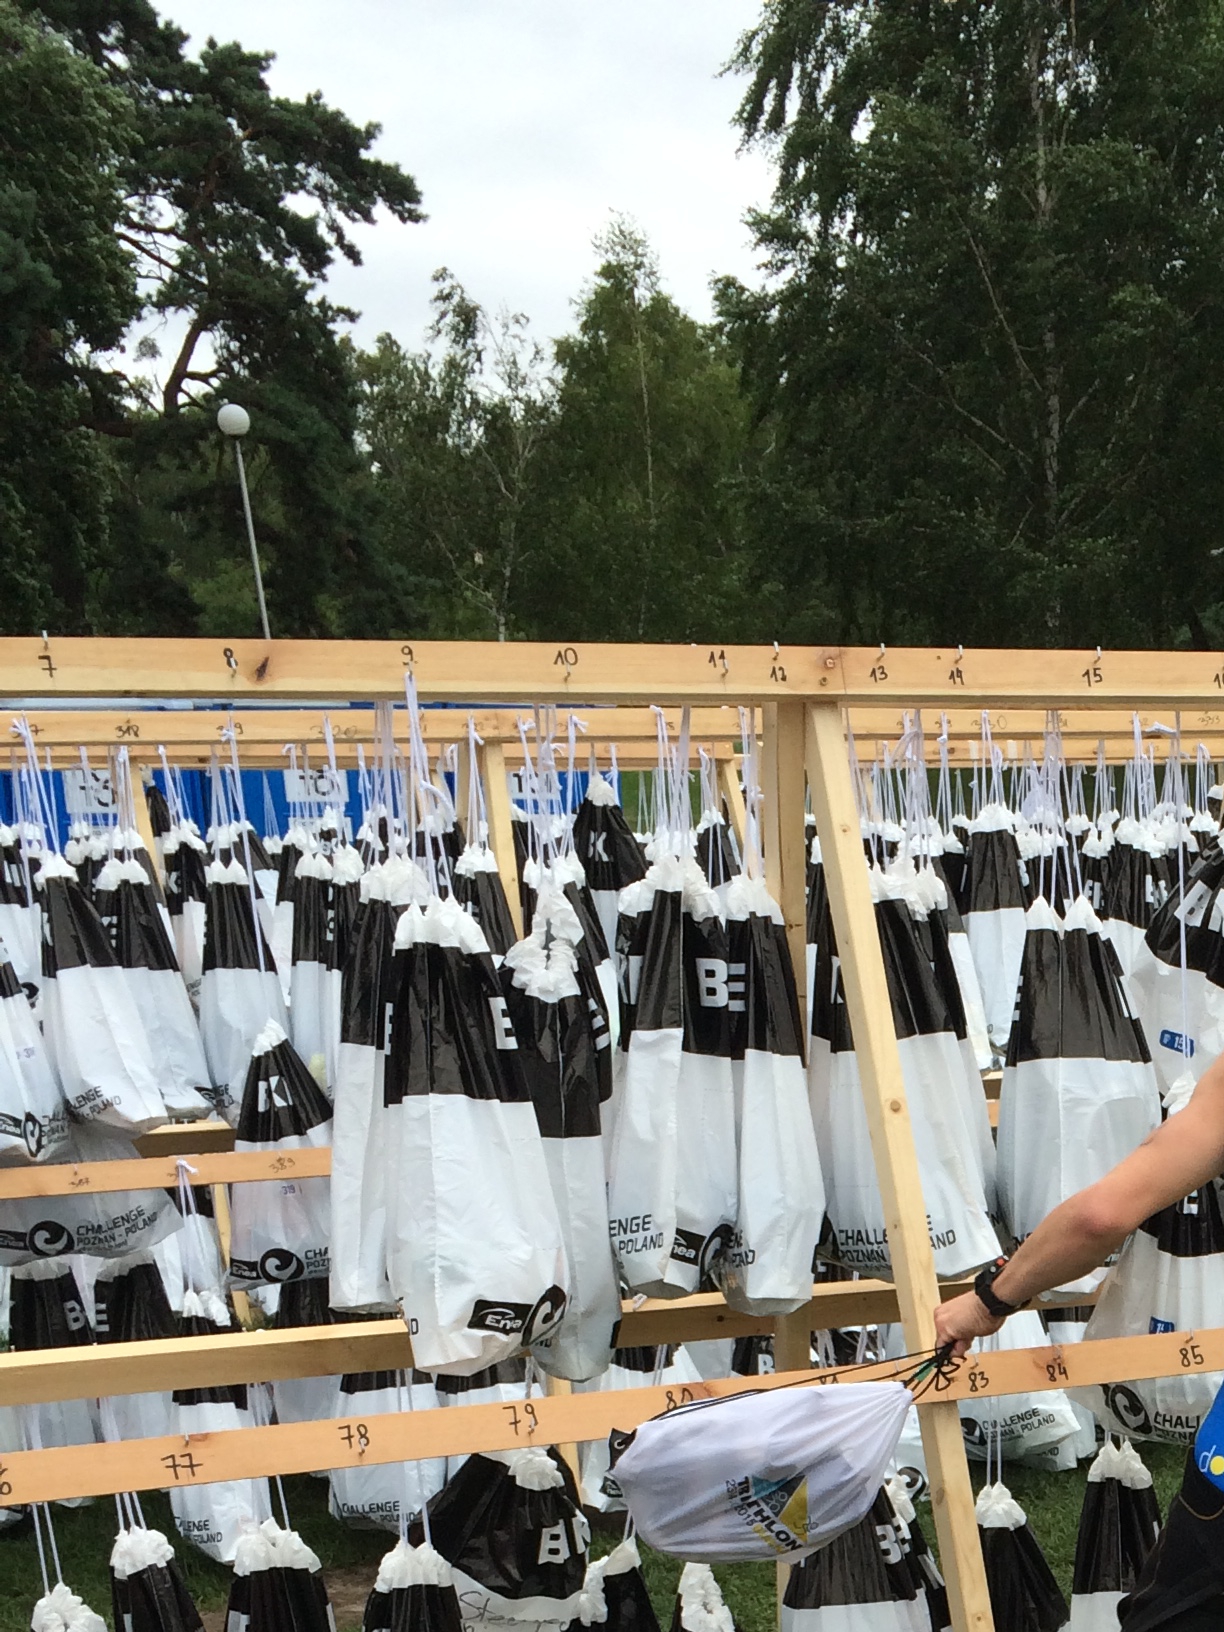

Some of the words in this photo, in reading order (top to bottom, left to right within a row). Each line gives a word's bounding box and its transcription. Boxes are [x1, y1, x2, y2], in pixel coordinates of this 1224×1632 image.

[37, 654, 57, 678] 7
[553, 647, 579, 666] 10
[769, 665, 787, 683] 12
[870, 665, 889, 683] 13
[948, 667, 965, 686] 14
[1082, 667, 1103, 687] 15
[618, 1232, 664, 1255] POLAND
[1179, 1344, 1205, 1368] 85
[968, 1371, 989, 1393] 83
[1046, 1363, 1069, 1383] 84
[502, 1403, 539, 1435] 79
[337, 1423, 370, 1450] 78
[161, 1452, 203, 1480] 77
